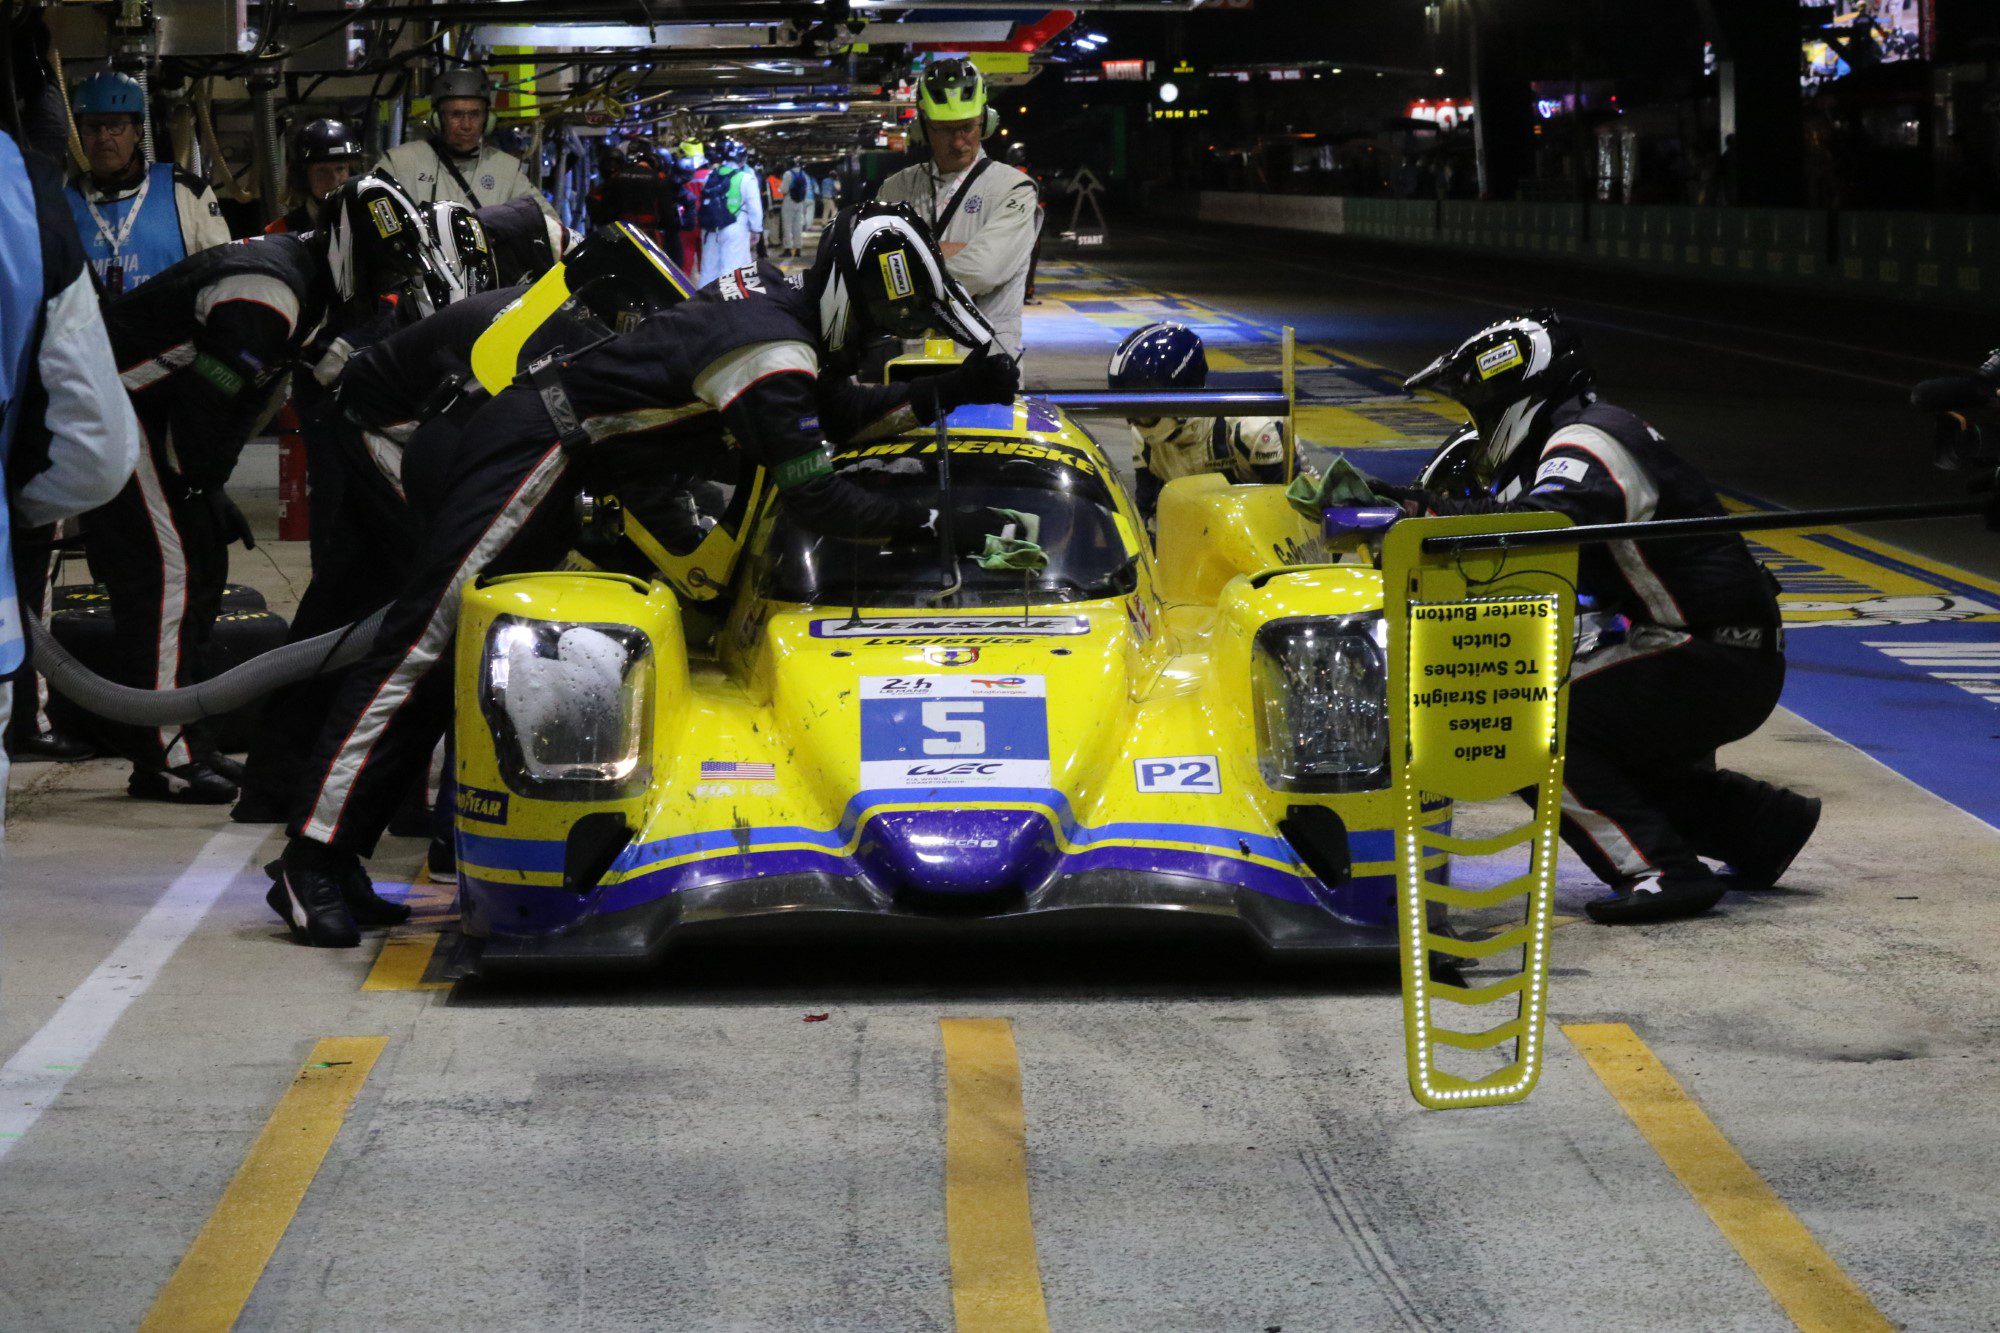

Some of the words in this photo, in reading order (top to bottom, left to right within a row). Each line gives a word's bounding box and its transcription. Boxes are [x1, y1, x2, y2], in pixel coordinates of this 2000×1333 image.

[1079, 236, 1103, 244] START
[893, 257, 906, 291] PENSKE
[1416, 607, 1477, 621] Button
[1483, 603, 1548, 617] Starter
[864, 636, 1035, 647] Logistics
[1453, 633, 1511, 649] Clutch
[1424, 661, 1508, 678] Switches
[1515, 660, 1539, 675] TC
[1413, 688, 1487, 707] Straight
[1493, 686, 1549, 702] Wheel
[922, 701, 986, 755] 5
[1449, 716, 1512, 733] Brakes
[1455, 745, 1506, 761] Radio
[907, 762, 1004, 775] WEC
[1142, 762, 1213, 786] P2
